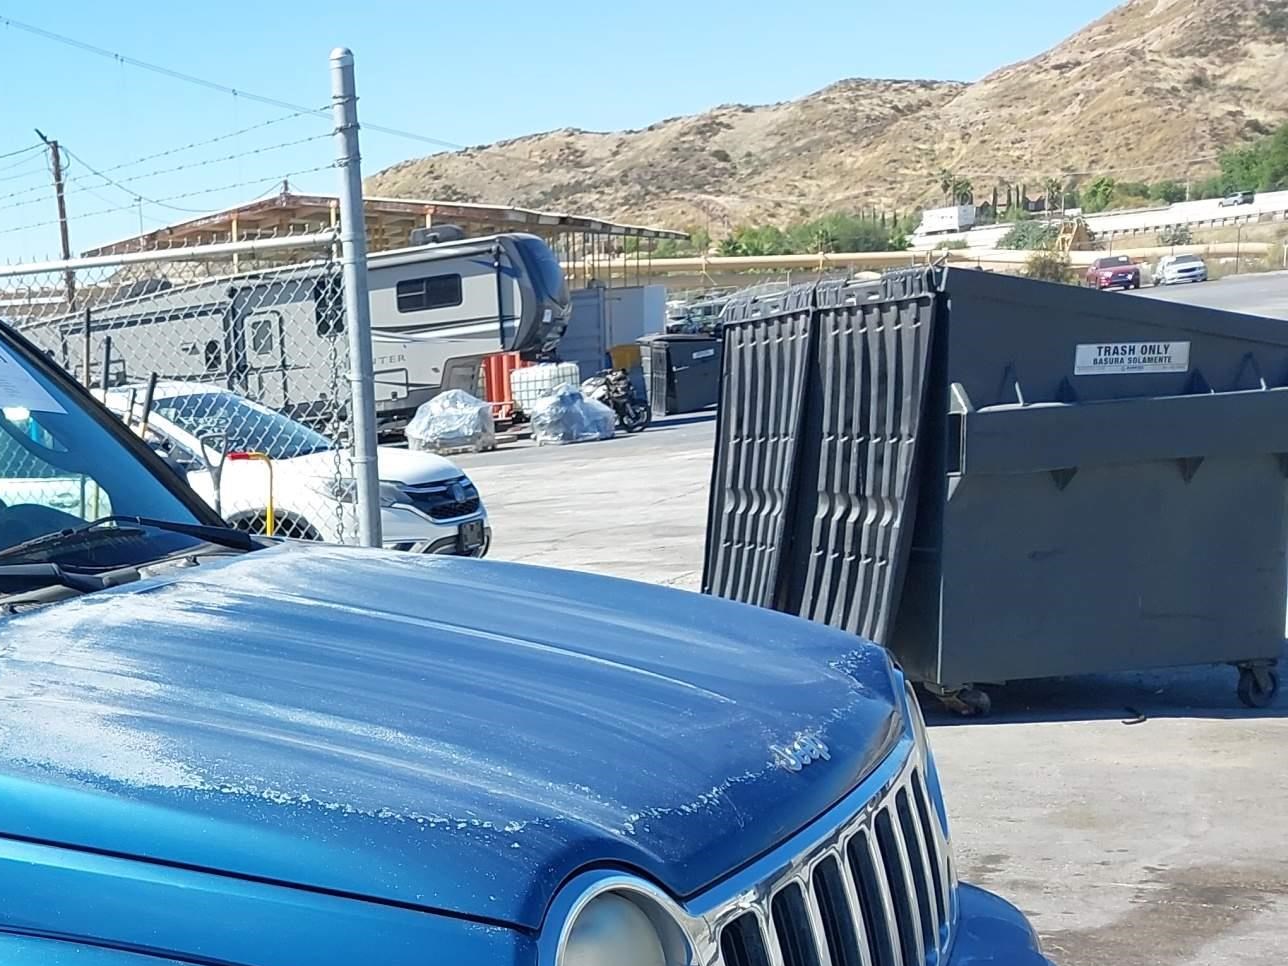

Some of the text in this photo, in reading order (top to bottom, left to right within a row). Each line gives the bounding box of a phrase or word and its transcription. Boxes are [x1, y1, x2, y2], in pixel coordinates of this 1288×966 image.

[1097, 344, 1170, 357] TRASH ONLY
[1093, 355, 1172, 366] BASURA SOLAMENTE
